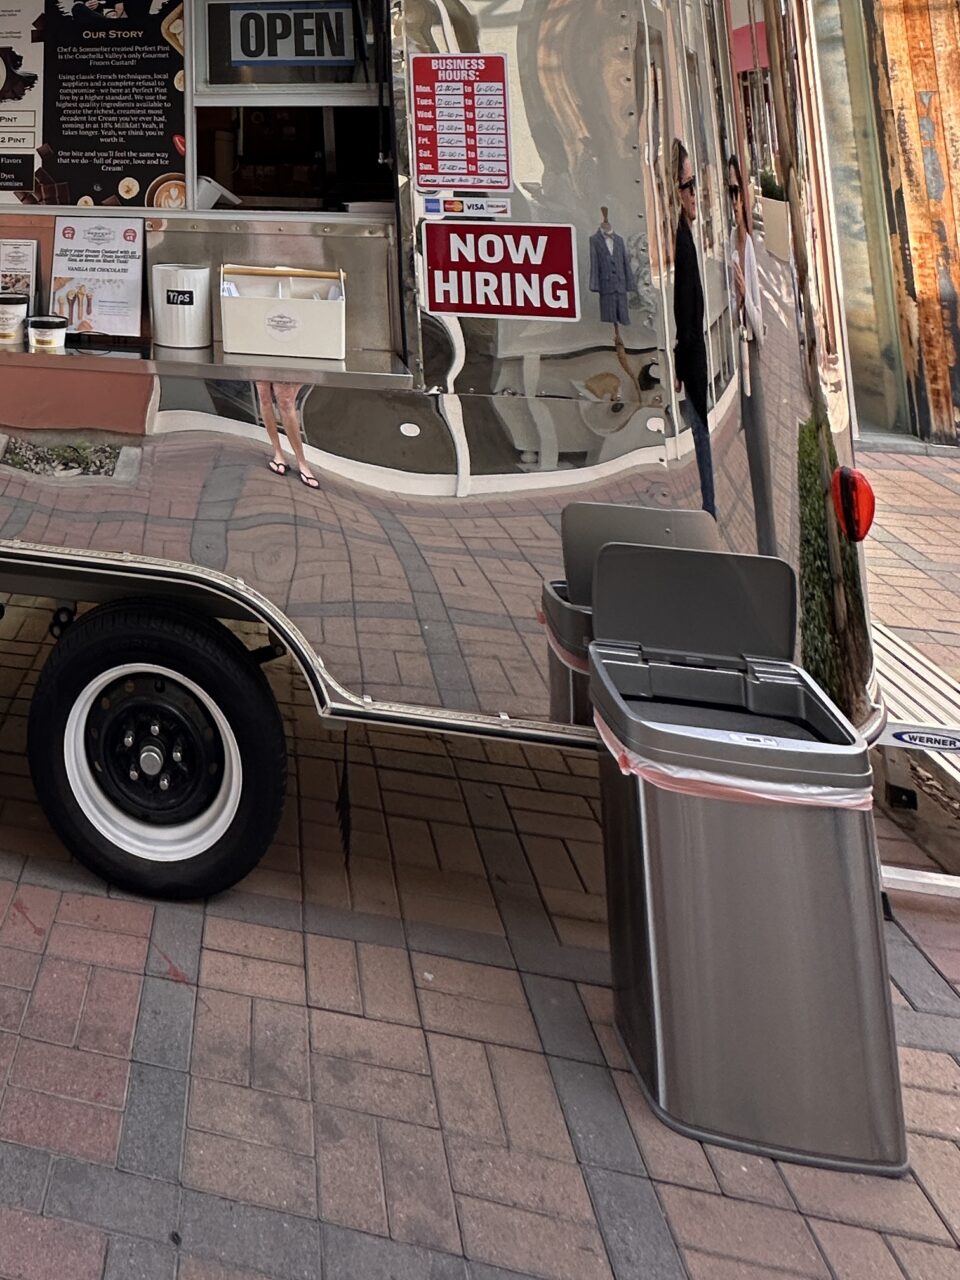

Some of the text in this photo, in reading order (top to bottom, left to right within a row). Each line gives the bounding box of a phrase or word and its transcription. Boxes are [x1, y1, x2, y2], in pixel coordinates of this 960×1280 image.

[241, 12, 345, 57] OPEN
[432, 59, 485, 69] BUSINESS
[438, 71, 480, 80] HOURS:
[450, 233, 548, 264] NOW
[434, 270, 568, 309] HIRING
[168, 292, 190, 304] Tips
[908, 735, 956, 747] WERNER
